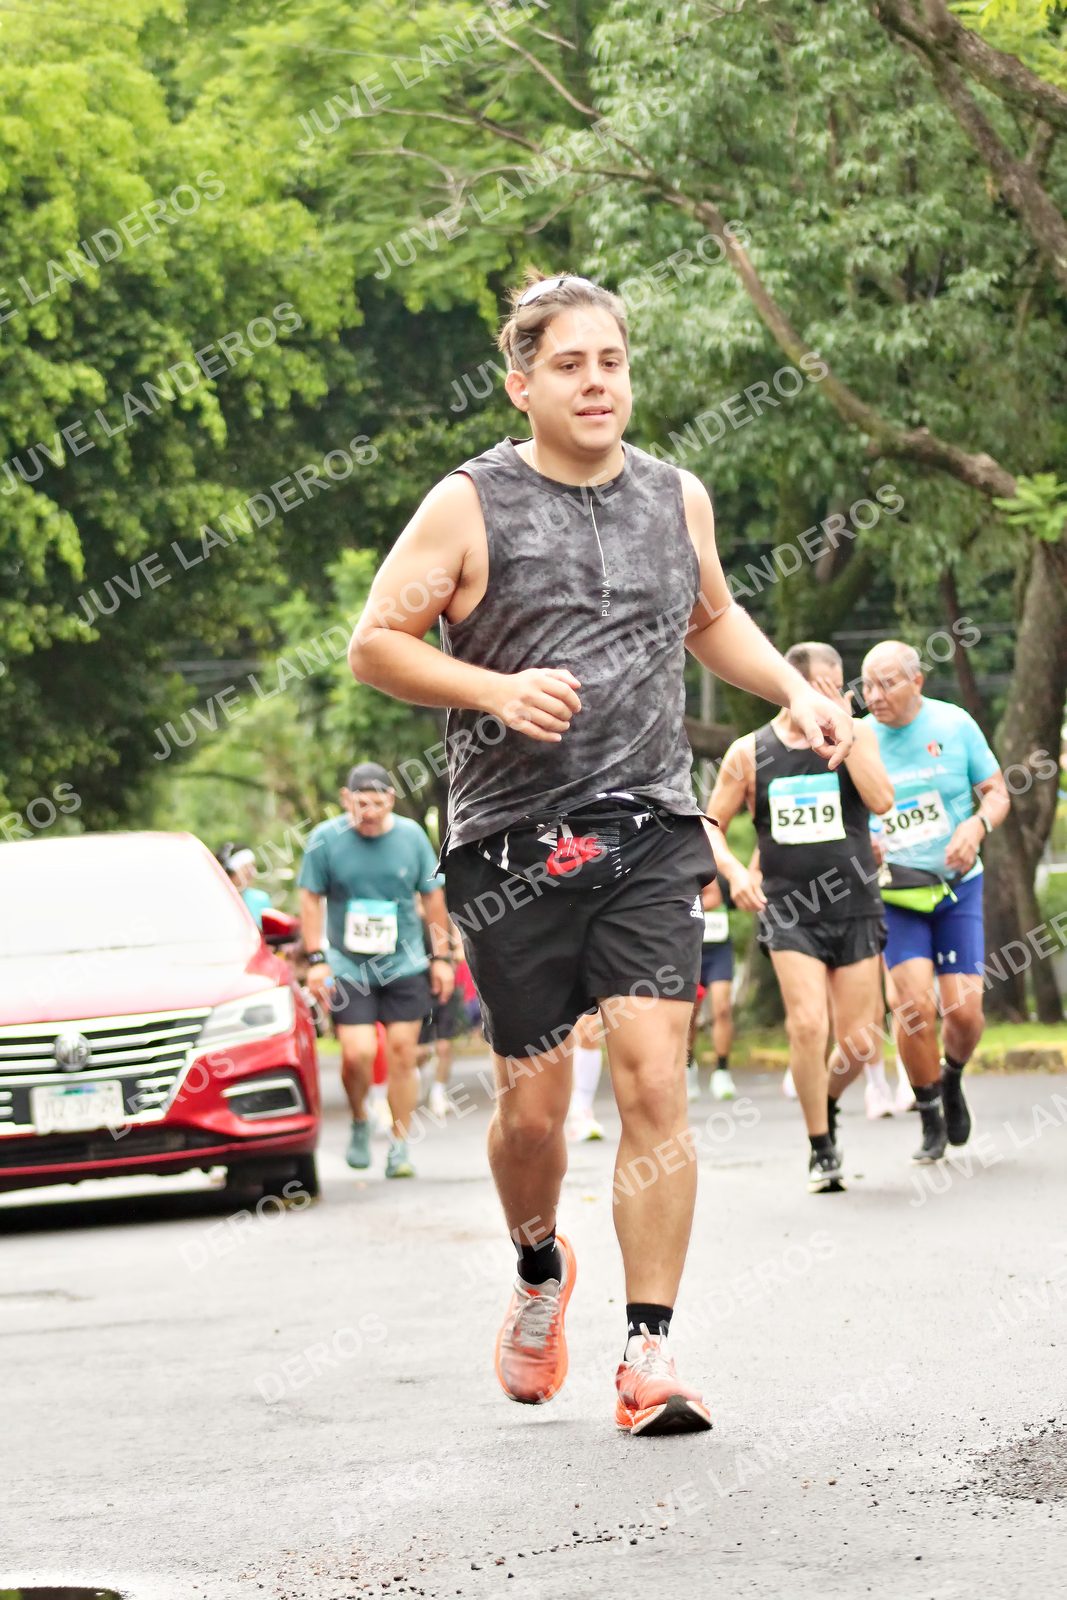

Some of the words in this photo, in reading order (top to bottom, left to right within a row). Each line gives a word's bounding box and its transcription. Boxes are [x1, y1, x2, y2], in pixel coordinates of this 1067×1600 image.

[602, 580, 610, 617] PUMA
[777, 805, 835, 827] 5219
[882, 803, 940, 835] 3093
